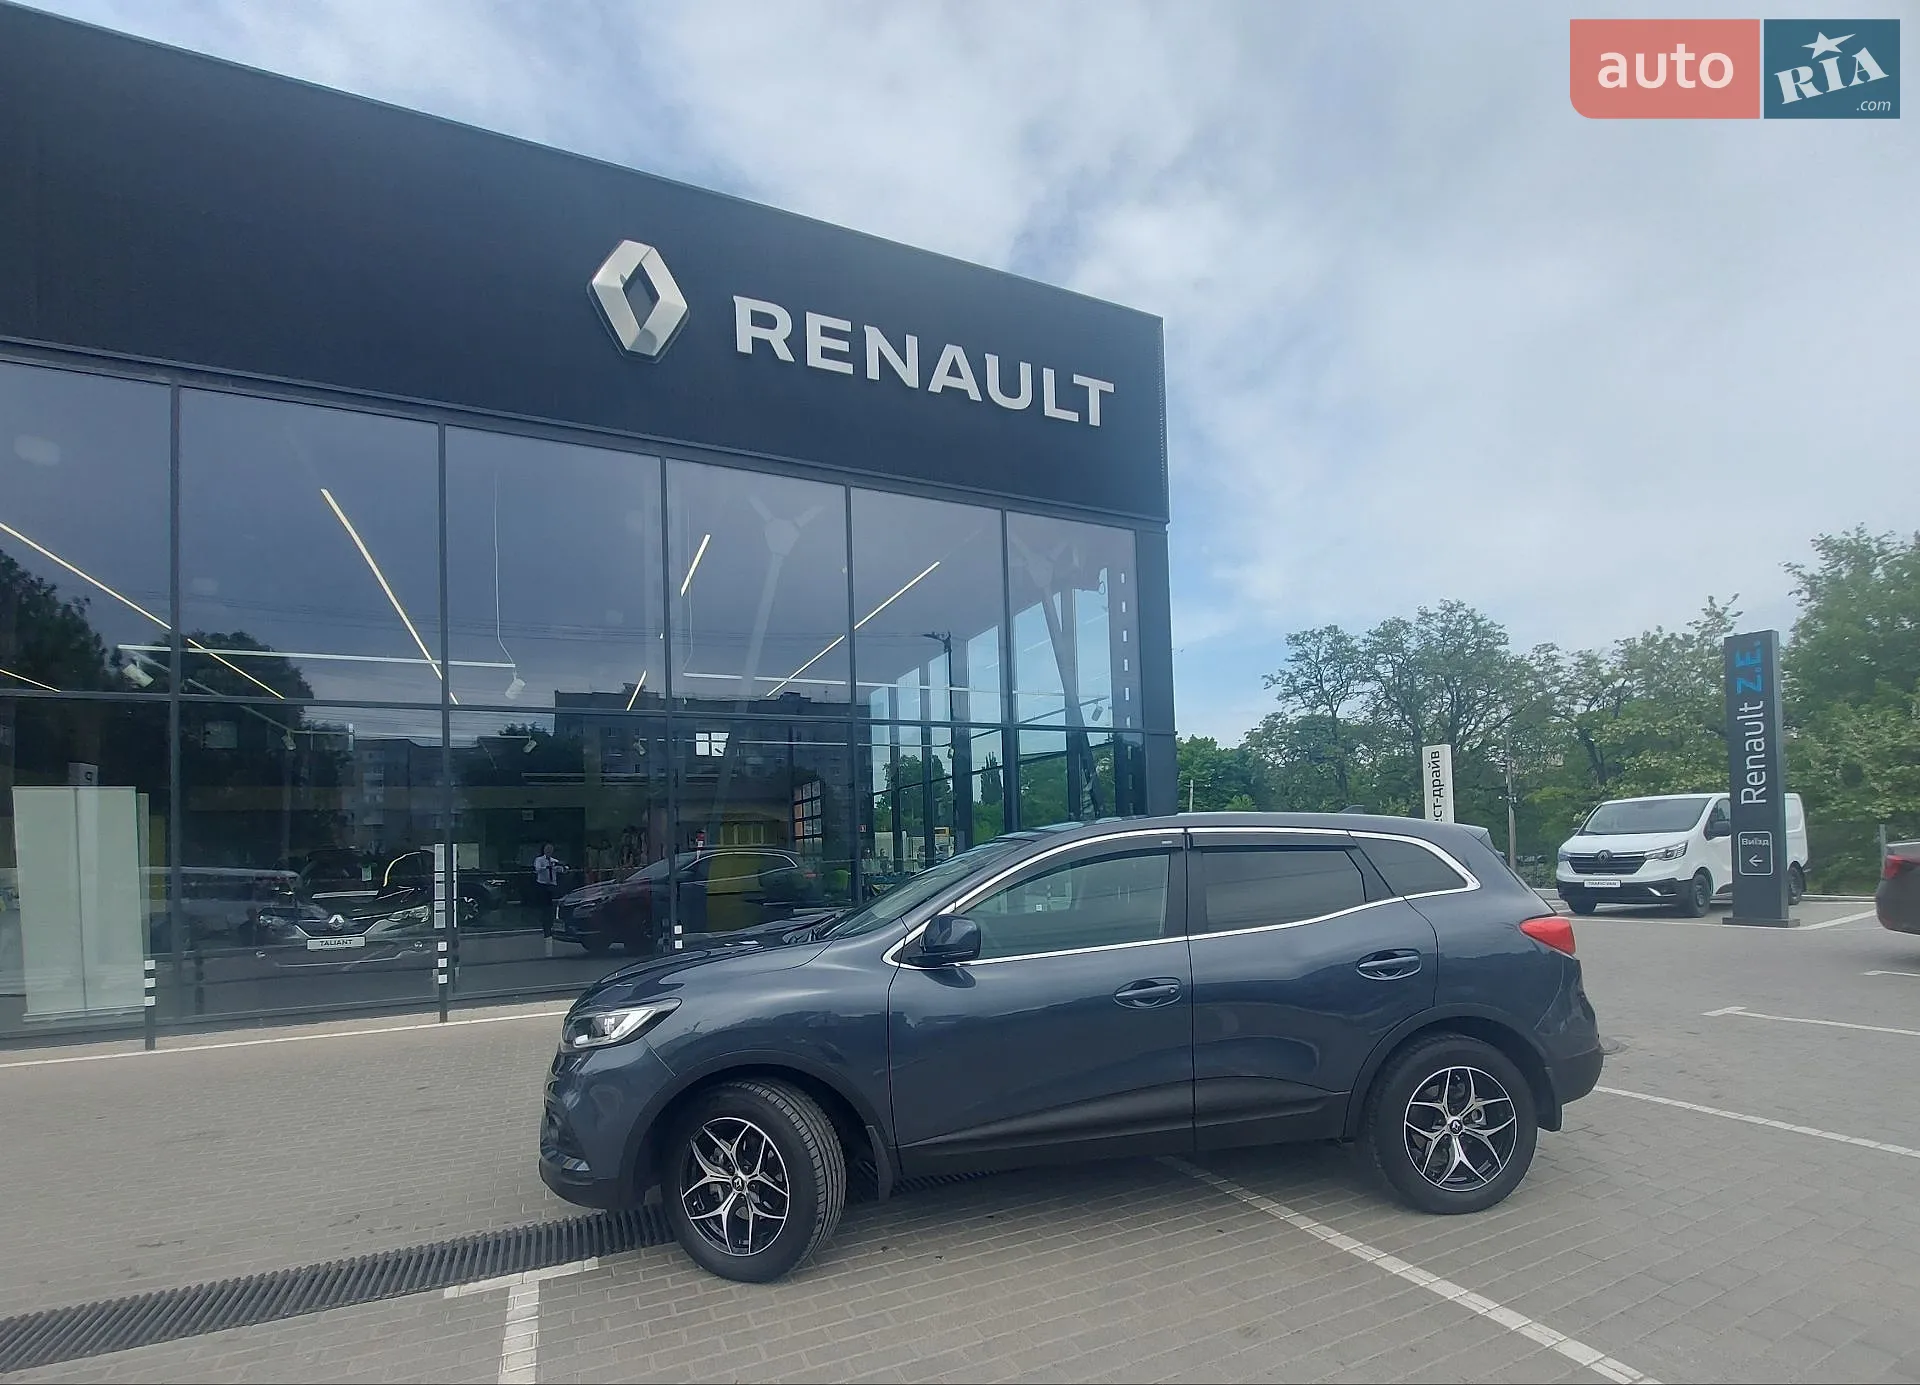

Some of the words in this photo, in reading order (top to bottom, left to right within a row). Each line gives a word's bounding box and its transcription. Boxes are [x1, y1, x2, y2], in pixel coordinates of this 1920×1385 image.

[733, 295, 1115, 427] RENAULT
[1735, 640, 1762, 694] Z.E.
[1428, 750, 1444, 822] ст-драйв
[1737, 700, 1767, 805] Renault
